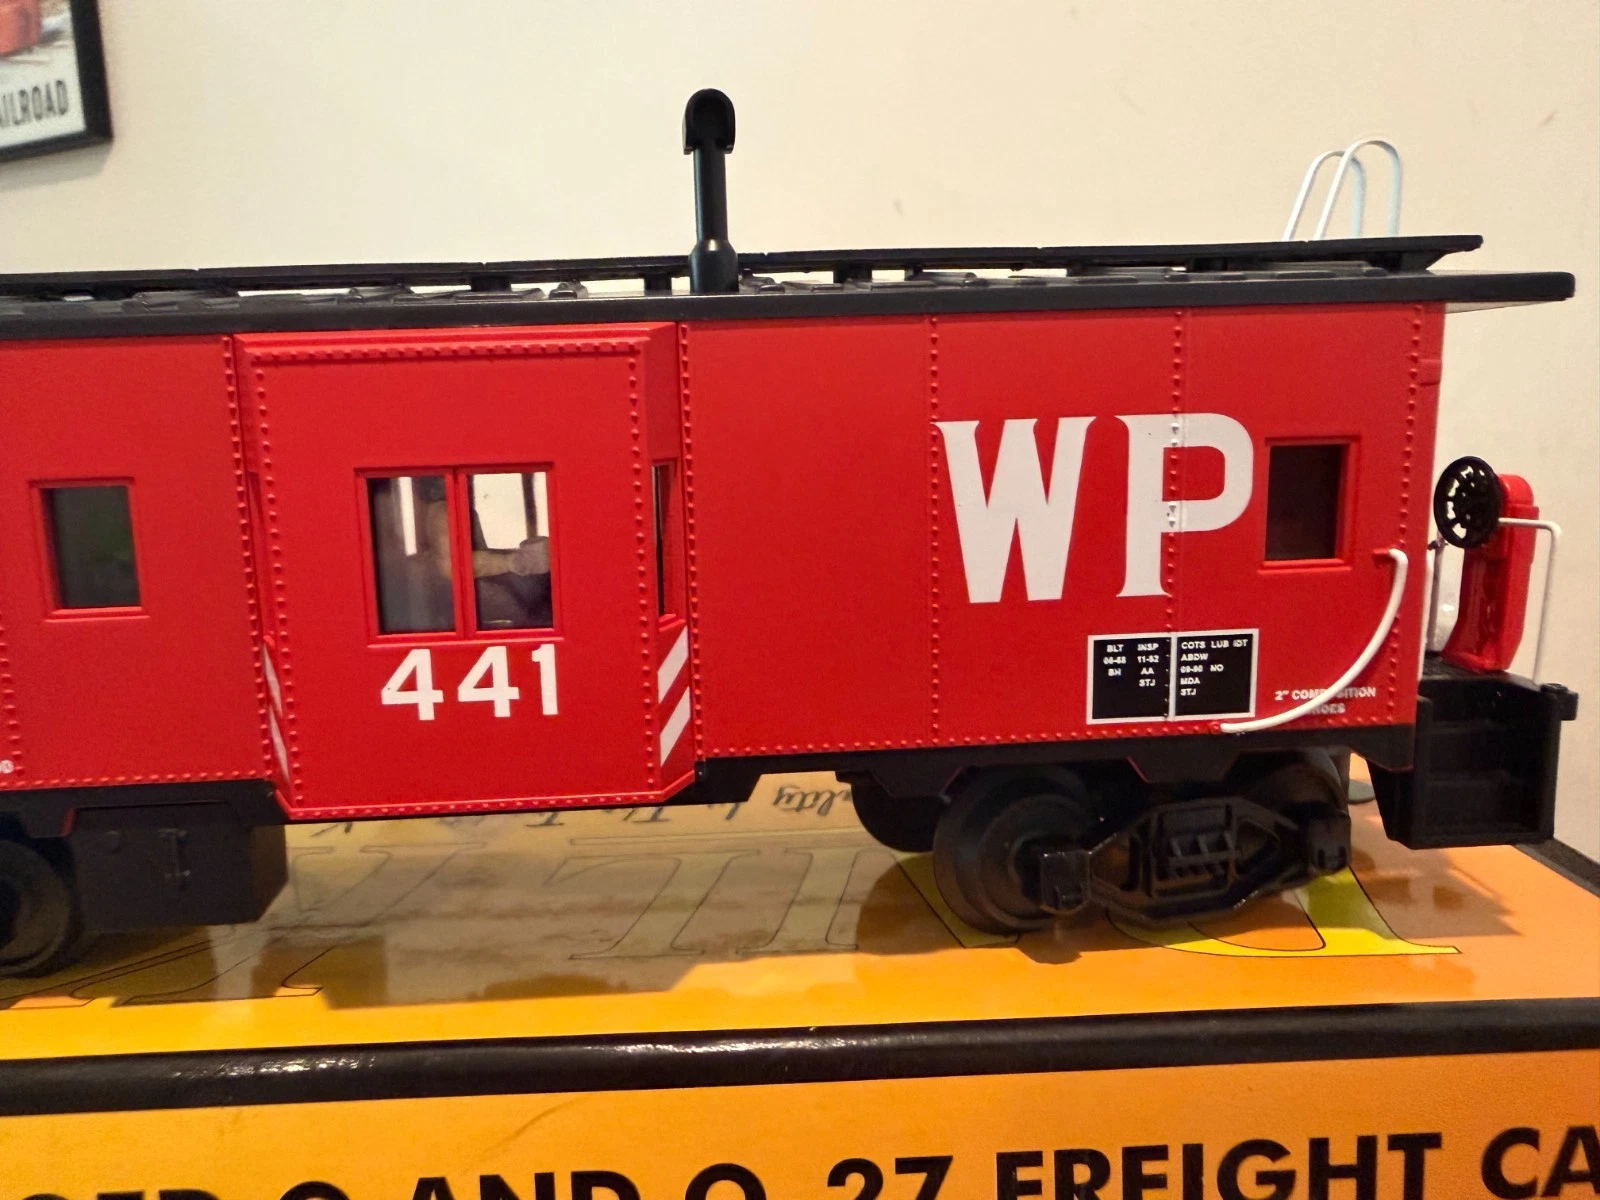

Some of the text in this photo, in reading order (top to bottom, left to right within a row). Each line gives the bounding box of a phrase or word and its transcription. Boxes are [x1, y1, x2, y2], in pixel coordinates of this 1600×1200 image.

[930, 412, 1254, 604] WP
[1106, 643, 1160, 653] BLT INSP
[1180, 641, 1206, 650] COTS
[1210, 640, 1230, 649] LUB
[1180, 653, 1209, 662] ABDW
[1140, 667, 1155, 676] AA
[380, 643, 558, 721] 441
[1180, 688, 1198, 697] STJ
[996, 1131, 1443, 1200] FREIGHT
